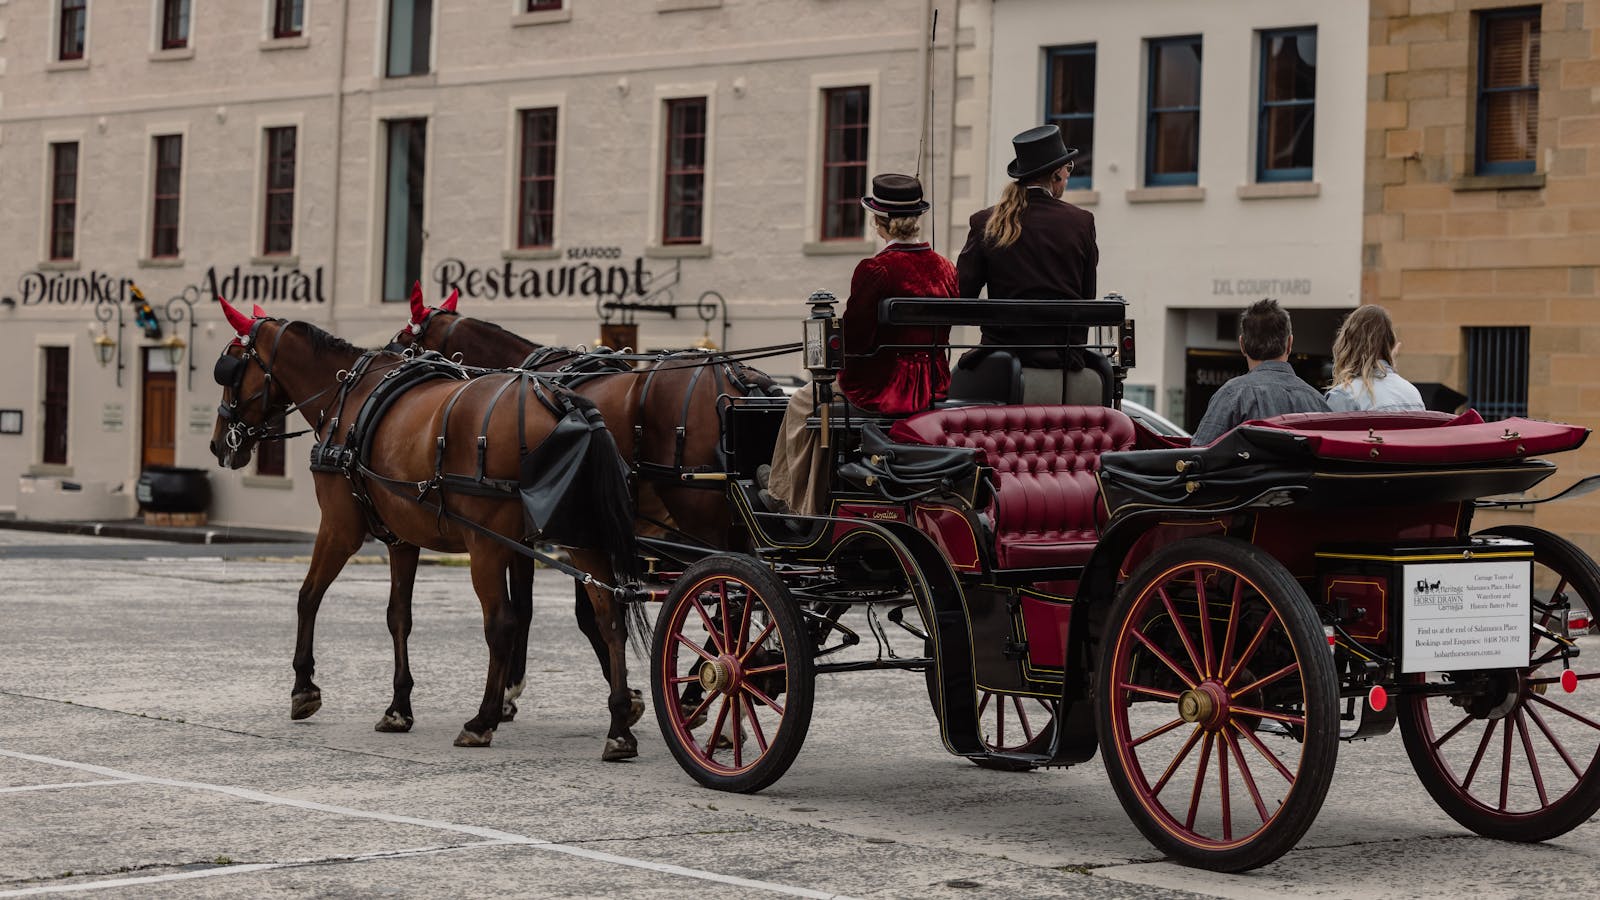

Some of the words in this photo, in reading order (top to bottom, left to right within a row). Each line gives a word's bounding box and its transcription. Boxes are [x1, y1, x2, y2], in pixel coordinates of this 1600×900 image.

[567, 247, 622, 259] SEAFOOD
[200, 265, 325, 304] Admiral
[433, 257, 650, 300] Restaurant
[1212, 279, 1234, 296] IXL
[1237, 279, 1313, 296] COURTYARD
[1413, 596, 1435, 606] HORSE
[1437, 595, 1463, 605] DRAWN
[1417, 627, 1431, 635] Find
[1445, 626, 1454, 634] the
[1455, 625, 1467, 633] end
[1474, 623, 1503, 632] Salamanca
[1503, 623, 1518, 631] Place
[1415, 639, 1441, 648] Bookings
[1441, 638, 1453, 646] and
